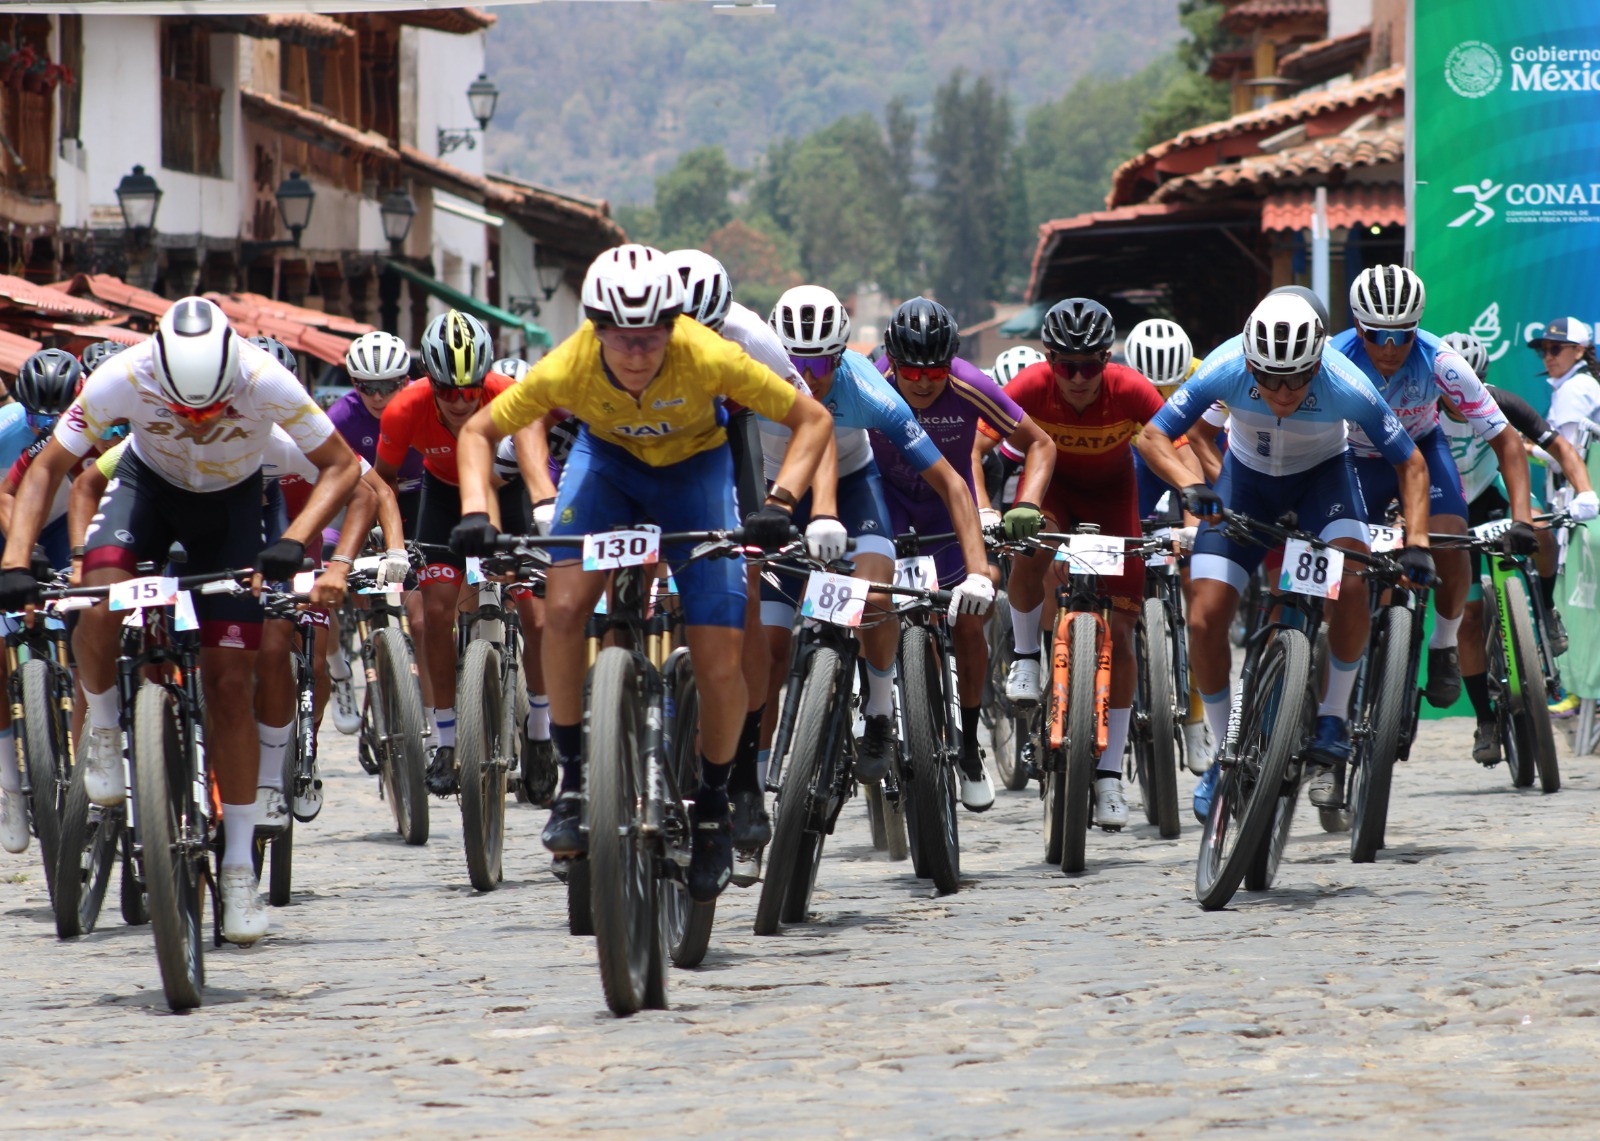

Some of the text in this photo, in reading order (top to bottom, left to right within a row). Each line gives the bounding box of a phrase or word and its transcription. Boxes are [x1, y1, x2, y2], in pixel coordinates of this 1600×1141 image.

[1510, 45, 1600, 62] Gobierno
[593, 537, 648, 561] 130
[1295, 552, 1330, 585] 88
[128, 582, 159, 600] 15
[818, 582, 853, 613] 89
